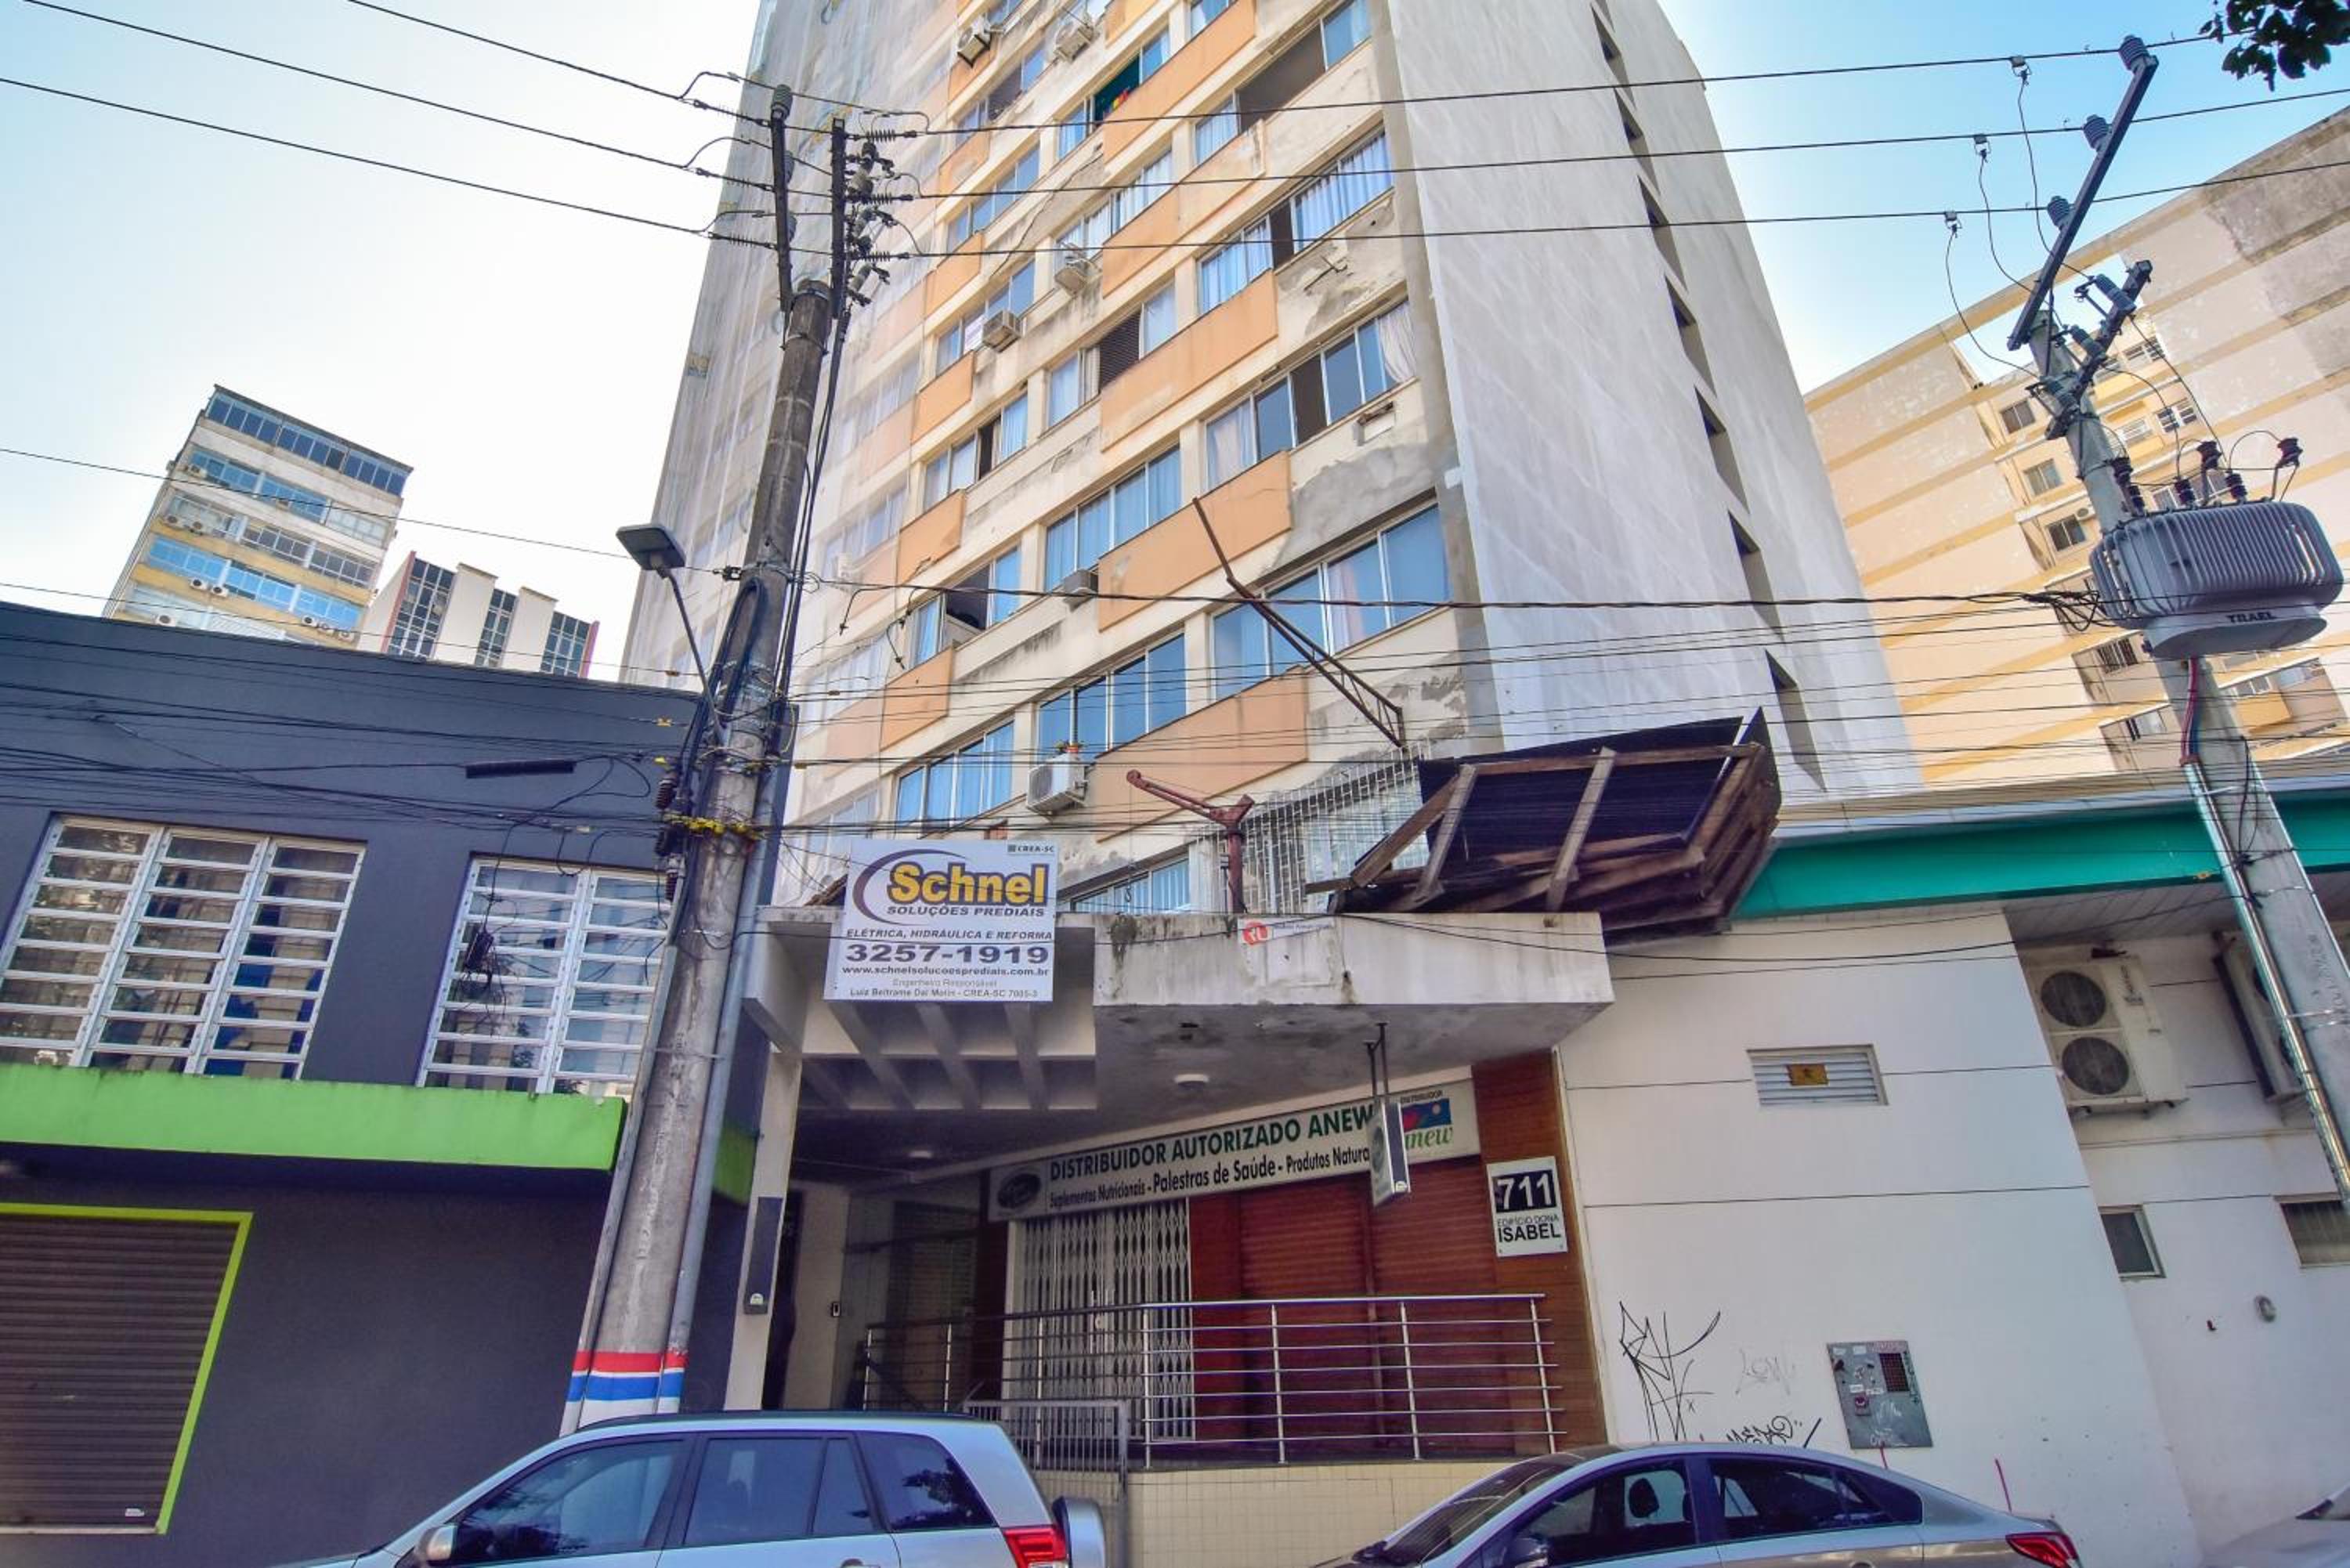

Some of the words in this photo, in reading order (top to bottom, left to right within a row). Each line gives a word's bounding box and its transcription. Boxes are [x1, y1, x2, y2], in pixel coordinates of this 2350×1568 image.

[887, 862, 1049, 906] Schnel
[887, 905, 969, 917] SOLUÇÕES
[974, 907, 1045, 917] PREDIAIS
[909, 928, 982, 939] HIDRÁULICA
[985, 930, 993, 939] E
[996, 930, 1053, 940] REFORMA
[845, 943, 1050, 964] 3257-1919
[1050, 1143, 1166, 1181] DISTRIBUIDOR
[1171, 1118, 1301, 1162] AUTORIZADO
[1153, 1169, 1210, 1193] Palestras
[1213, 1162, 1230, 1184] de
[1234, 1153, 1276, 1182] Saúde
[1285, 1151, 1331, 1174] Produtos
[1496, 1172, 1553, 1210] 711
[1497, 1223, 1561, 1243] ISABEL
